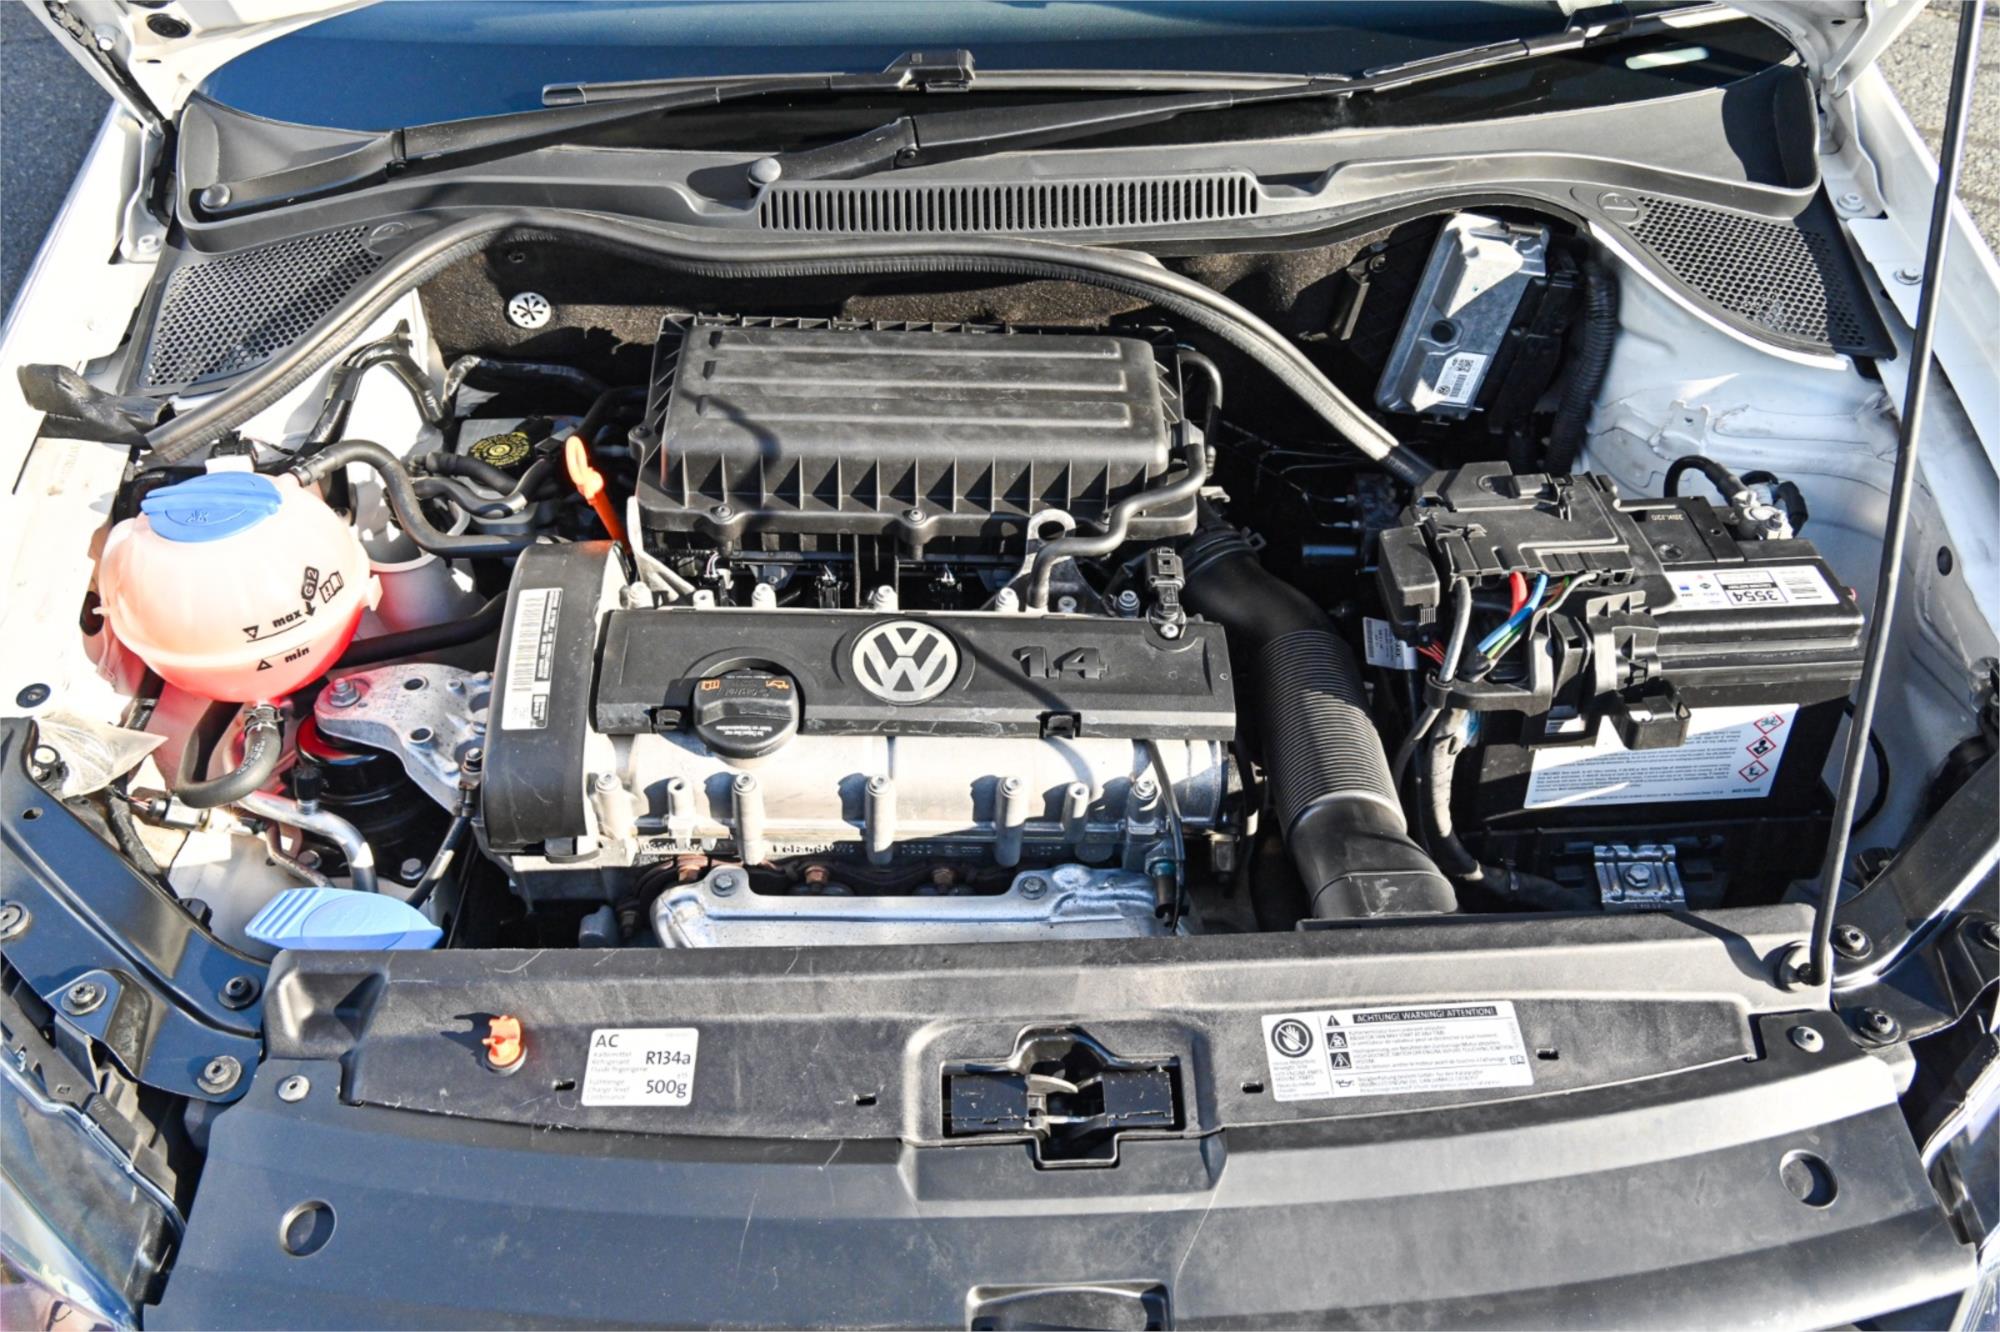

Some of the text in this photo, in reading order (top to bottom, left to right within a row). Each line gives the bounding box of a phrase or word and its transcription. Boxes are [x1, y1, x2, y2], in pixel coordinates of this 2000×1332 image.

[303, 568, 318, 599] G12
[1732, 590, 1778, 603] 3554
[272, 610, 302, 628] max
[284, 647, 310, 663] min
[1011, 644, 1110, 680] 1.4
[1402, 1010, 1445, 1020] WARNING!
[1446, 1007, 1494, 1017] ATTENTION!
[595, 1034, 620, 1048] AC
[646, 1050, 691, 1065] R134a
[645, 1079, 687, 1099] 500g
